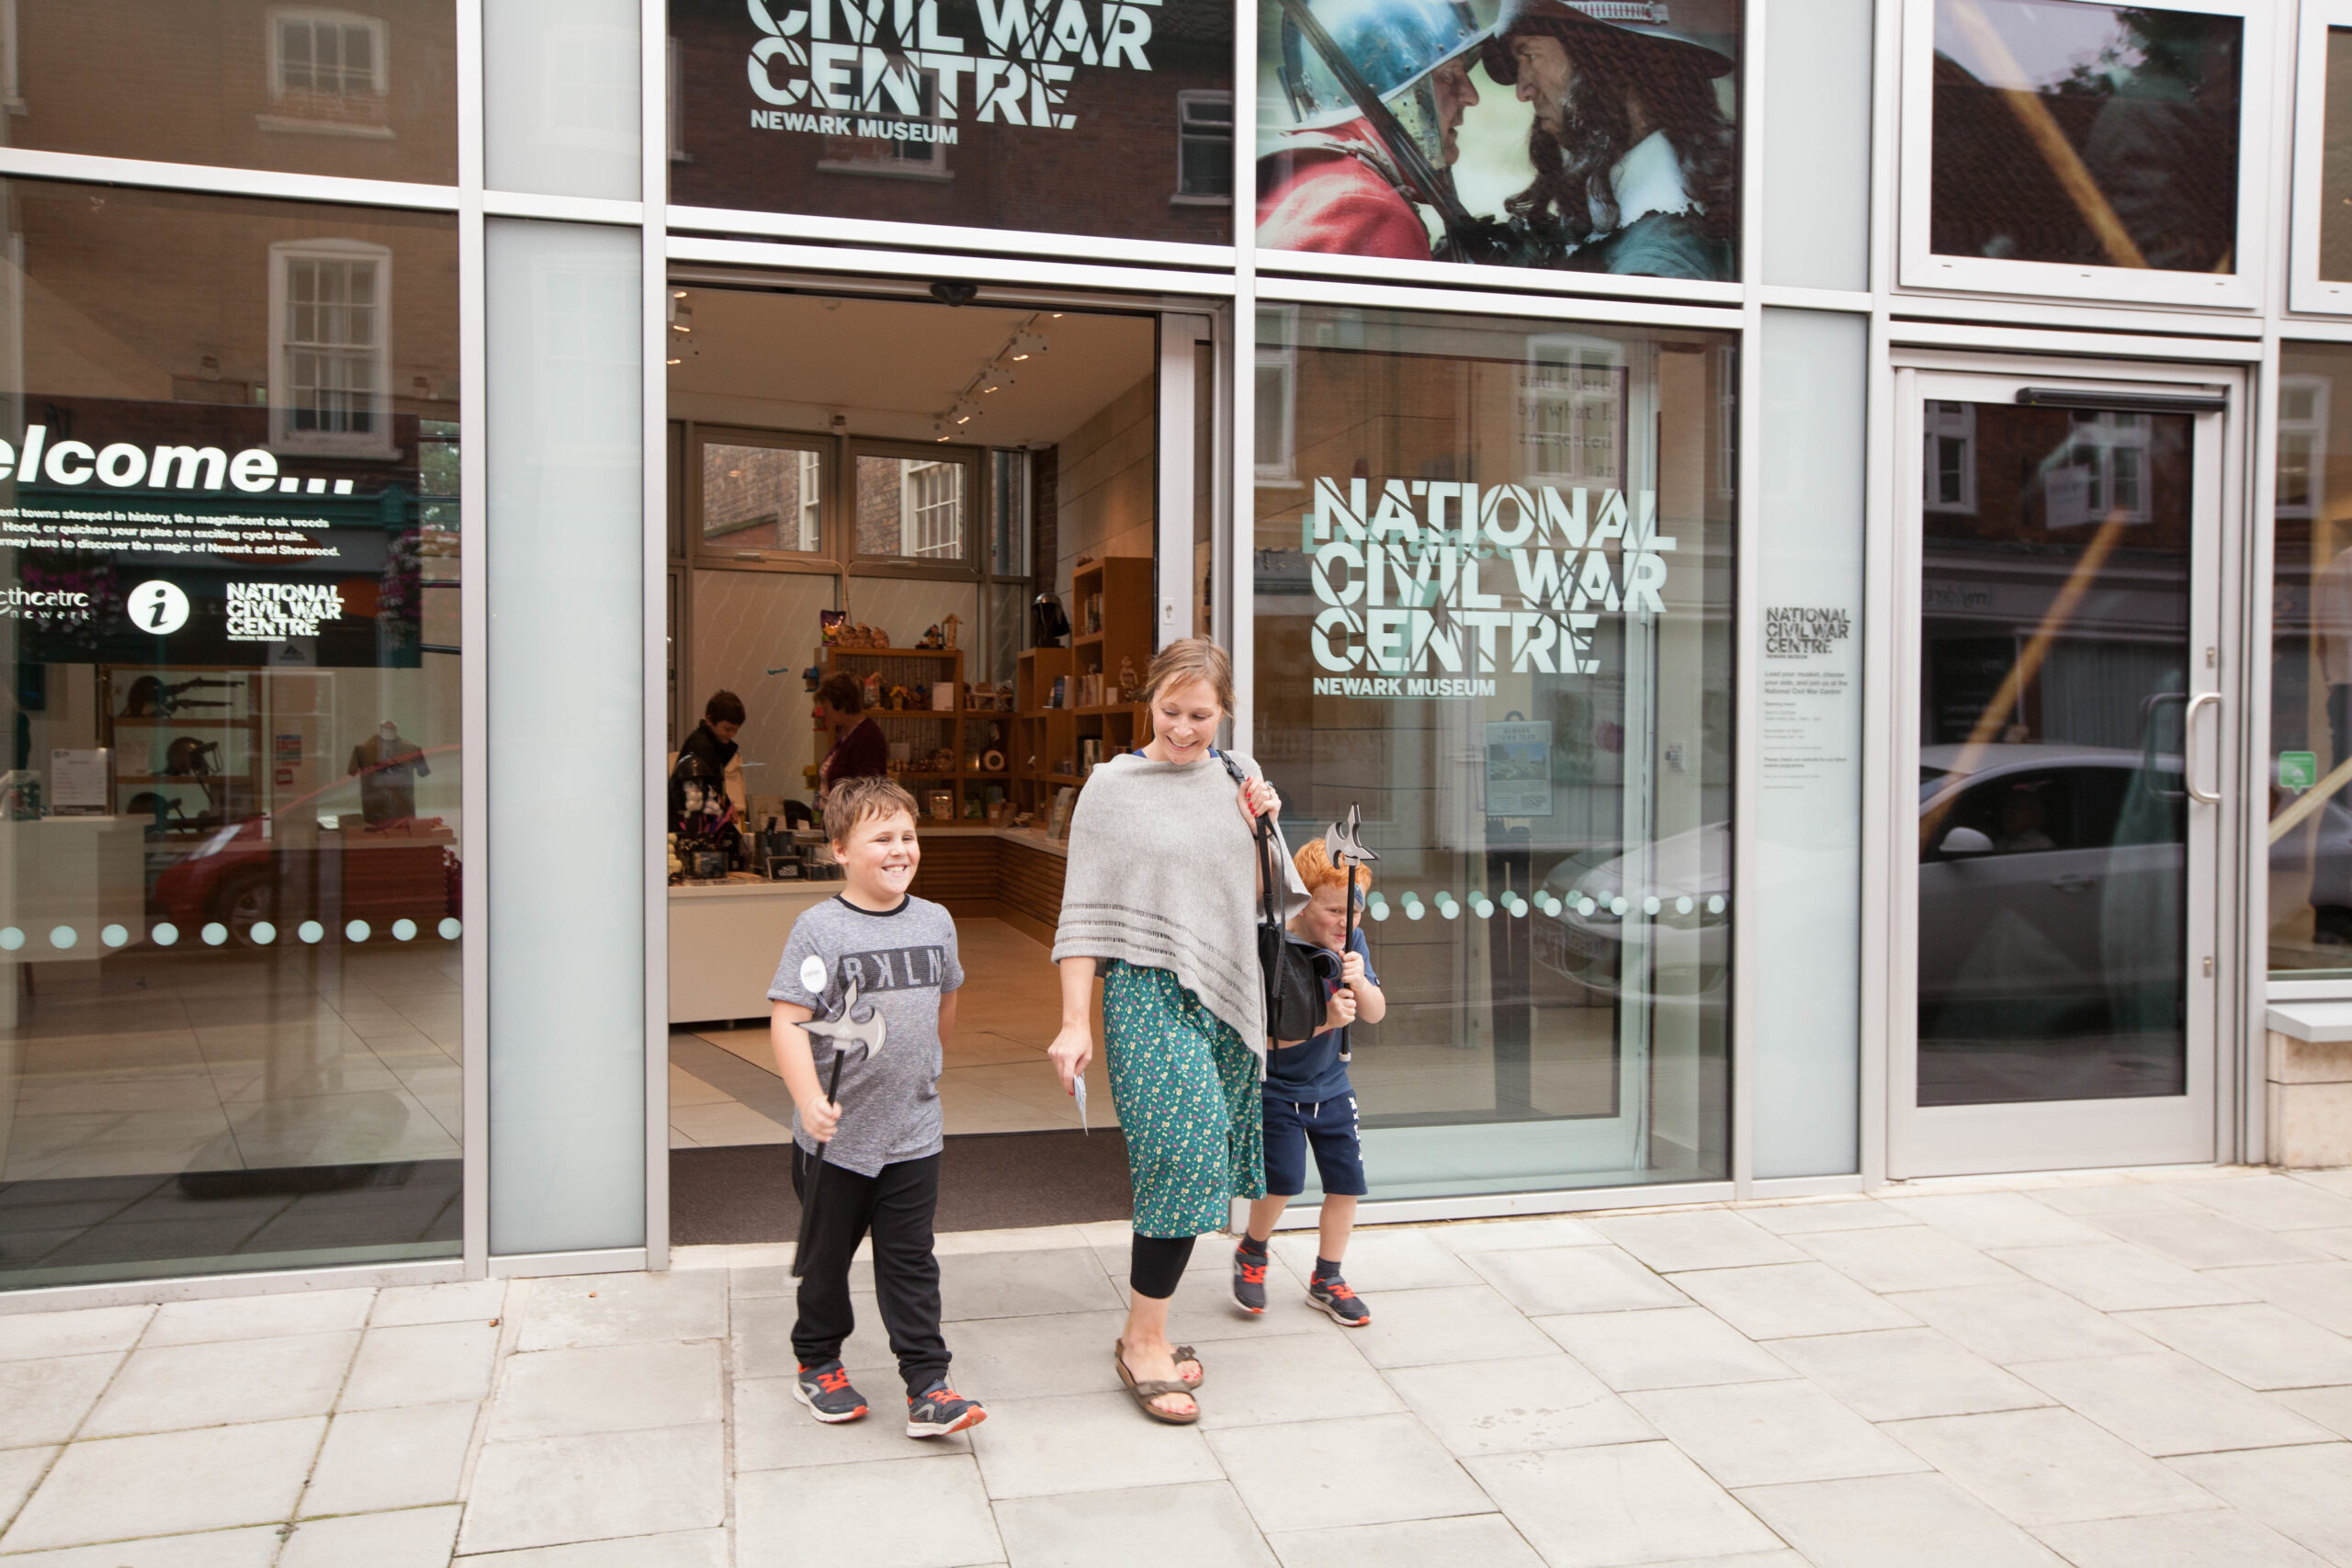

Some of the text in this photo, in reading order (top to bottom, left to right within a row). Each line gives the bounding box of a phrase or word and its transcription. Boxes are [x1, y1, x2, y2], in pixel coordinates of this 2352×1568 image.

[747, 0, 1153, 71] CIVIL WAR
[747, 36, 1077, 130] CENTRE
[751, 108, 958, 145] NEWARK MUSEUM
[21, 508, 61, 519] towns
[62, 510, 112, 522] steeped
[114, 511, 127, 522] in
[128, 512, 173, 525] history,
[175, 513, 194, 524] the
[196, 514, 265, 526] magnificent
[266, 517, 289, 526] oak
[291, 518, 330, 528] woods
[1313, 476, 1677, 551] NATIONAL
[43, 525, 58, 533] or
[60, 525, 108, 536] quicken
[110, 527, 139, 537] your
[140, 527, 174, 538] pulse
[193, 529, 241, 541] exciting
[242, 530, 273, 542] cycle
[275, 531, 307, 541] trails.
[30, 537, 60, 547] here
[61, 539, 75, 548] to
[76, 539, 130, 550] discover
[131, 541, 153, 551] the
[153, 542, 191, 554] magic
[192, 543, 206, 552] of
[208, 543, 254, 554] Newark
[254, 545, 277, 554] and
[278, 545, 341, 556] Sherwood.
[1311, 541, 1668, 613] CIVIL WAR
[226, 582, 345, 603] NATIONAL
[226, 600, 342, 620] CIVIL WAR
[1766, 607, 1851, 624] NATIONAL
[226, 617, 320, 636] CENTRE
[1766, 623, 1849, 638] CIVIL WAR
[1311, 606, 1600, 673] CENTRE
[1766, 637, 1832, 654] CENTRE
[1313, 678, 1496, 696] NEWARK MUSEUM
[842, 949, 943, 989] BKLN
